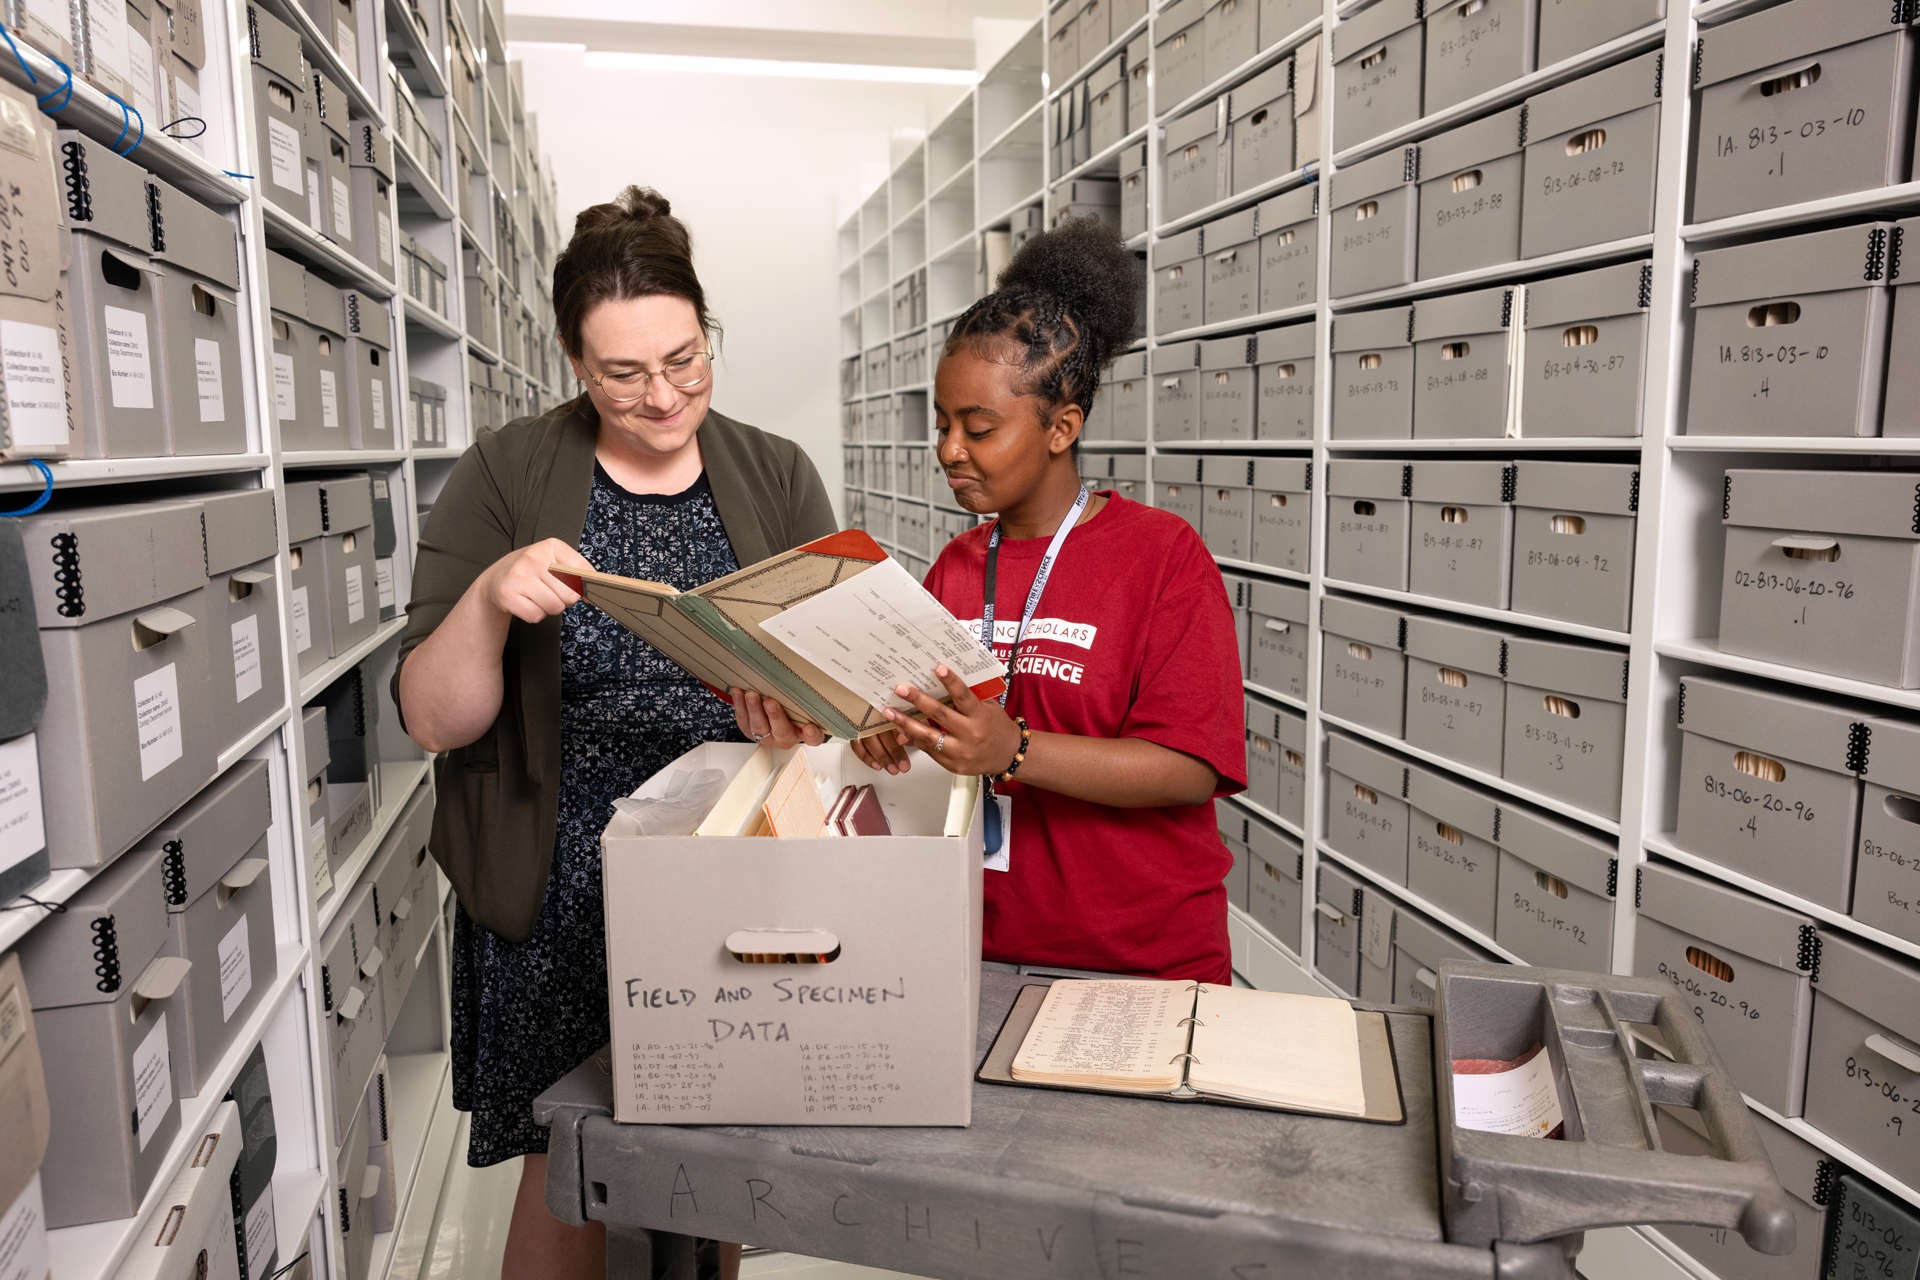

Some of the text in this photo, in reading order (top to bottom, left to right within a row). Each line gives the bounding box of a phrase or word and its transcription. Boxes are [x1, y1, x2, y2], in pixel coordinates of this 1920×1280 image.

[1026, 645, 1038, 654] OF
[1703, 774, 1816, 822] 813-06-20-96
[1738, 815, 1758, 840] .4
[624, 976, 905, 1009] FIELD AND SPECIMEN
[707, 1018, 791, 1042] DATA
